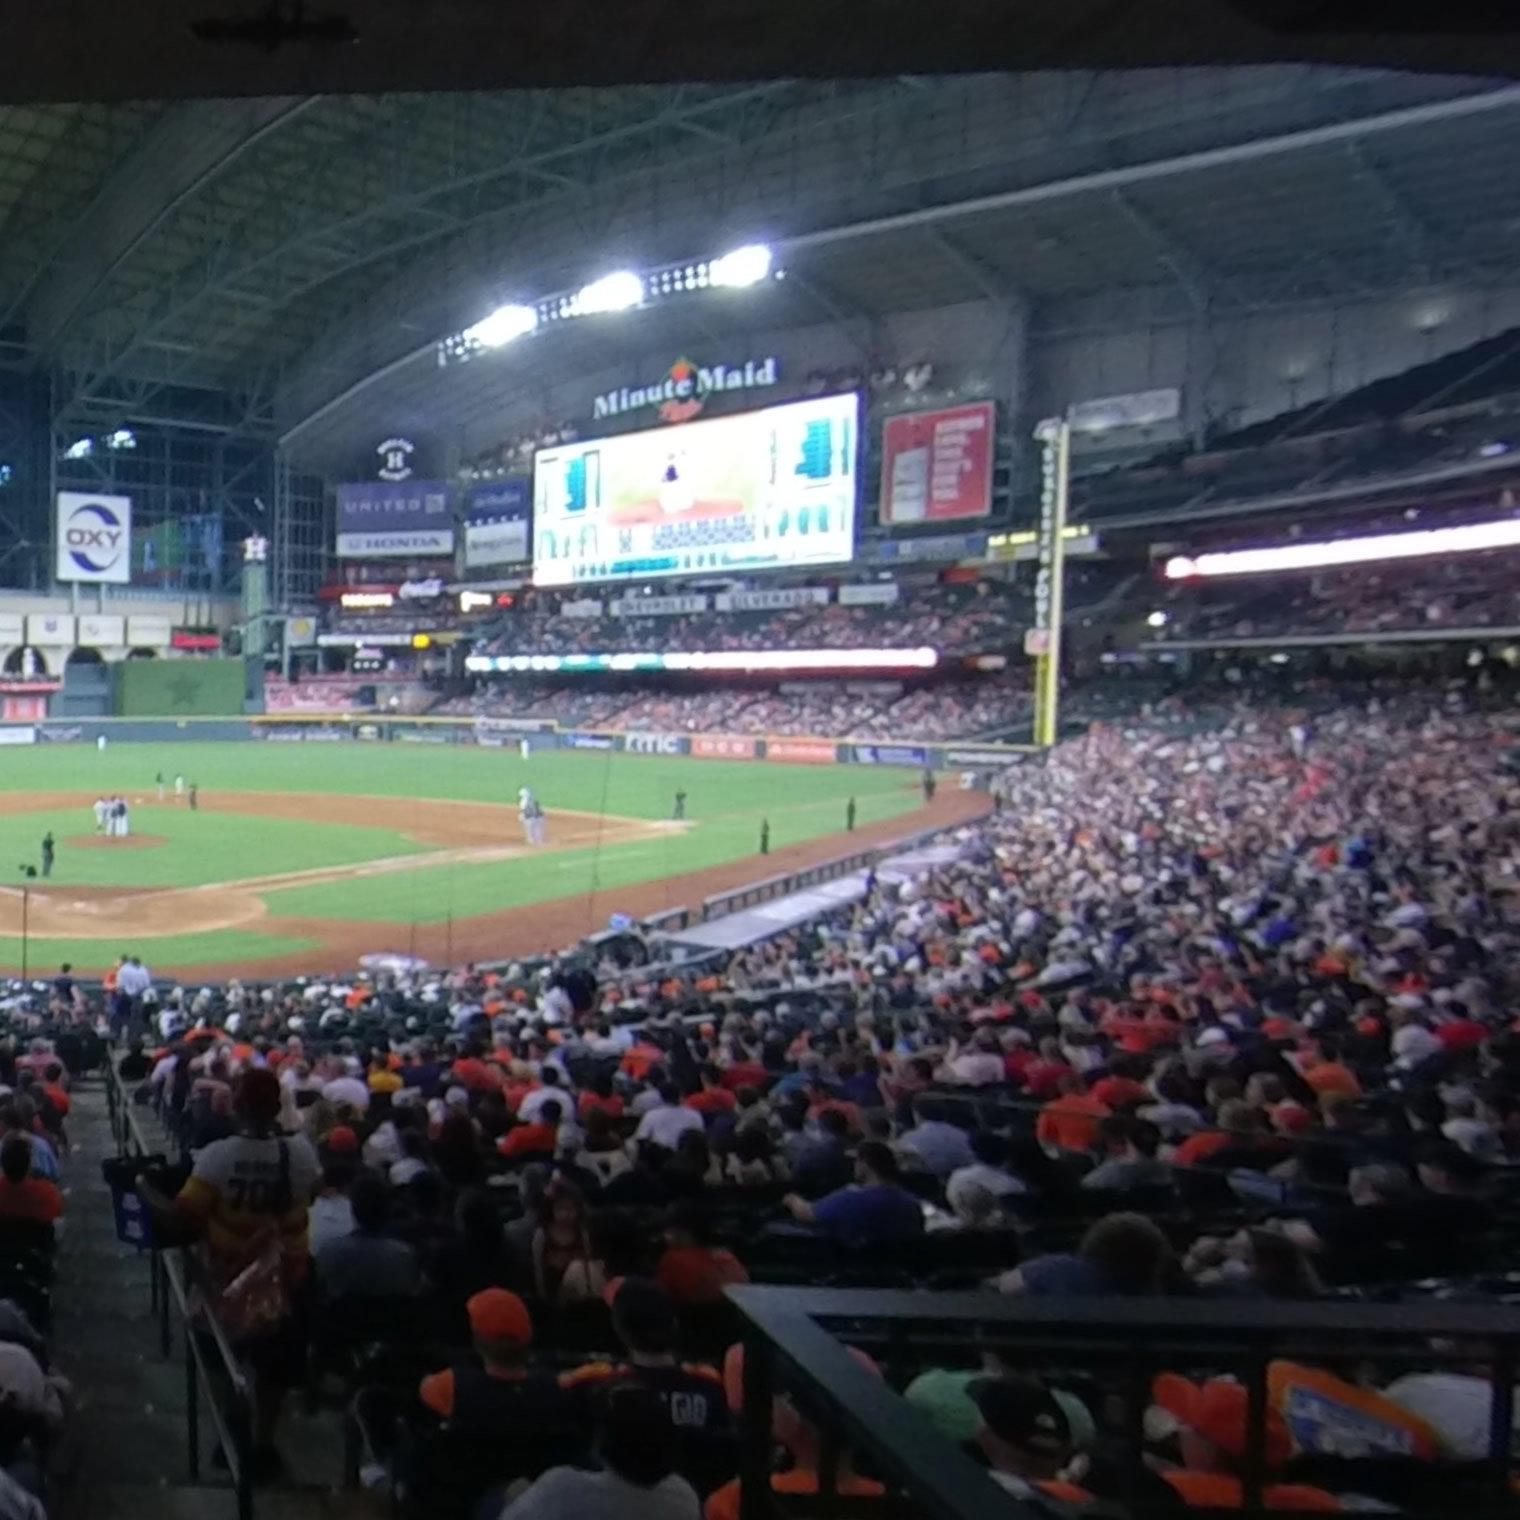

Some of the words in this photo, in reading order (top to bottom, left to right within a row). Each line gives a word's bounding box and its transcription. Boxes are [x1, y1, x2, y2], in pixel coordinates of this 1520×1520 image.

[592, 379, 694, 419] Minute
[695, 358, 777, 393] Maid
[344, 498, 422, 513] UNITED
[65, 527, 122, 547] OXY
[365, 537, 441, 550] HONDA
